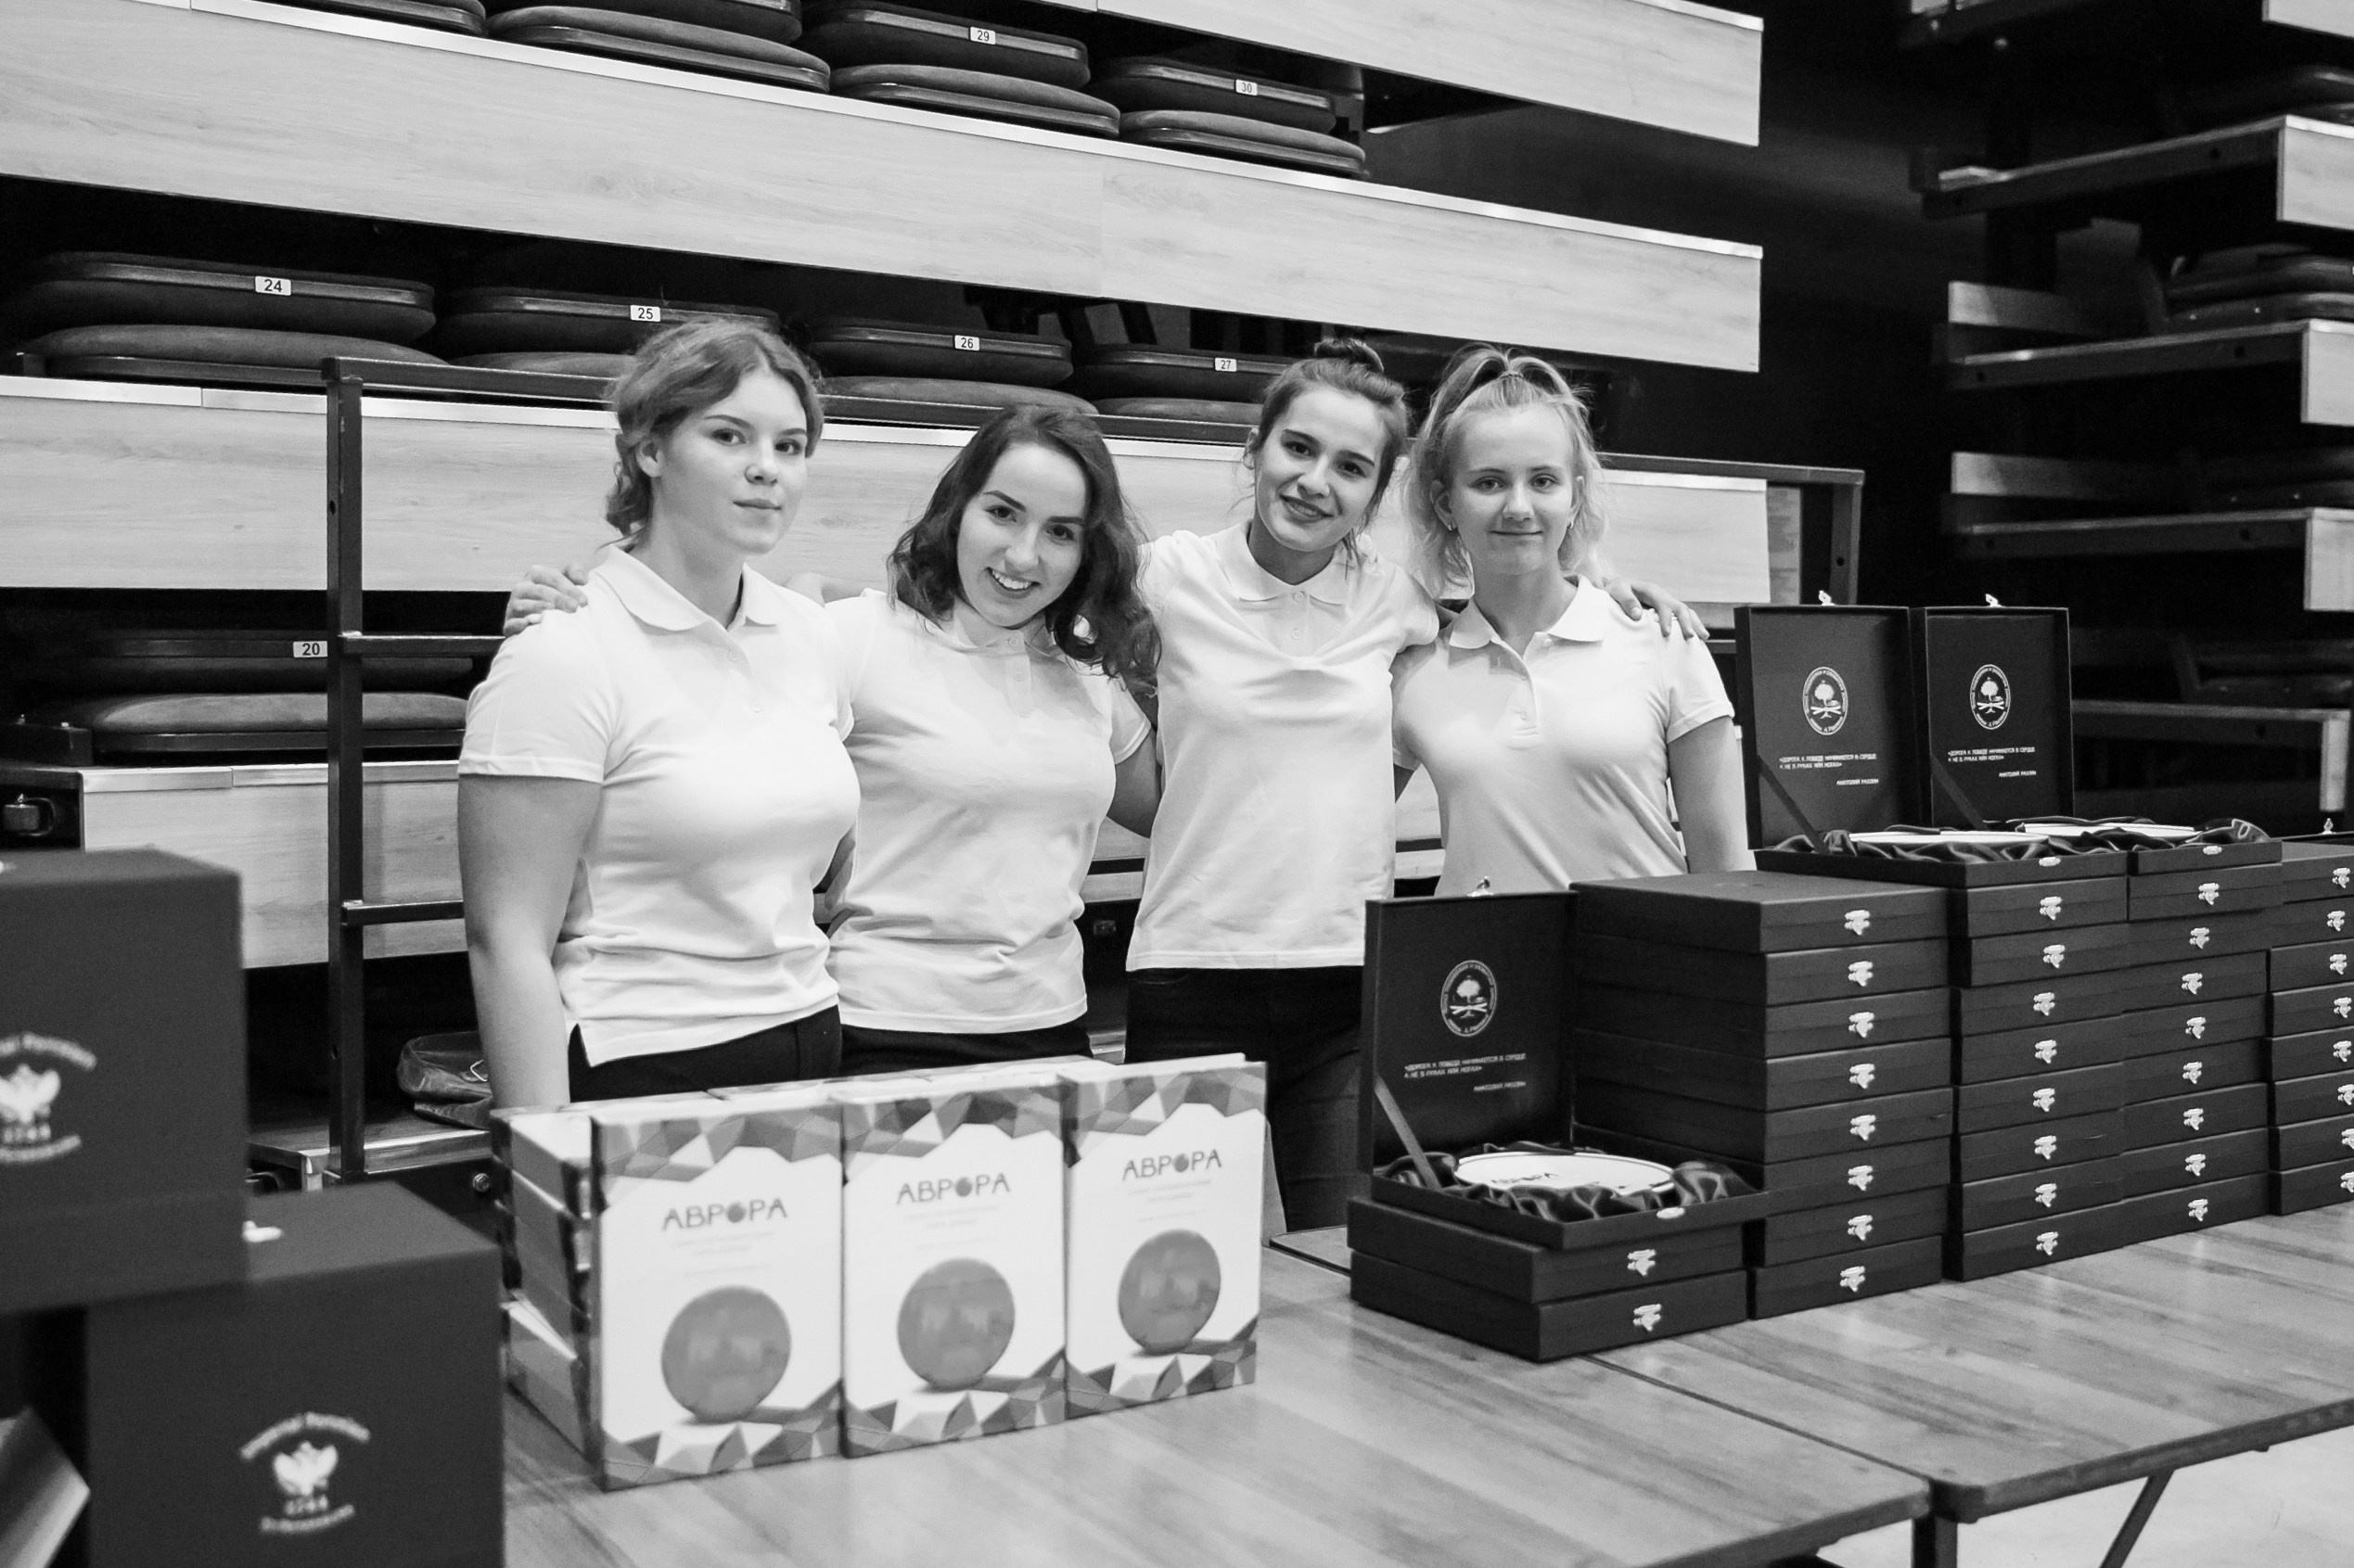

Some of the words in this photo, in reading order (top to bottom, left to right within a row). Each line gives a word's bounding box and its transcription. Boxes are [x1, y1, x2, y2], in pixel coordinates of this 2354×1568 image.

[977, 29, 990, 42] 29
[1241, 82, 1252, 94] 30
[263, 278, 283, 293] 24
[637, 307, 653, 320] 25
[961, 337, 974, 349] 26
[1221, 359, 1232, 370] 27
[301, 642, 321, 657] 20
[1121, 1148, 1222, 1181] АВРОРА
[895, 1171, 1010, 1205] АВРОРА
[660, 1197, 787, 1232] АВРОРА
